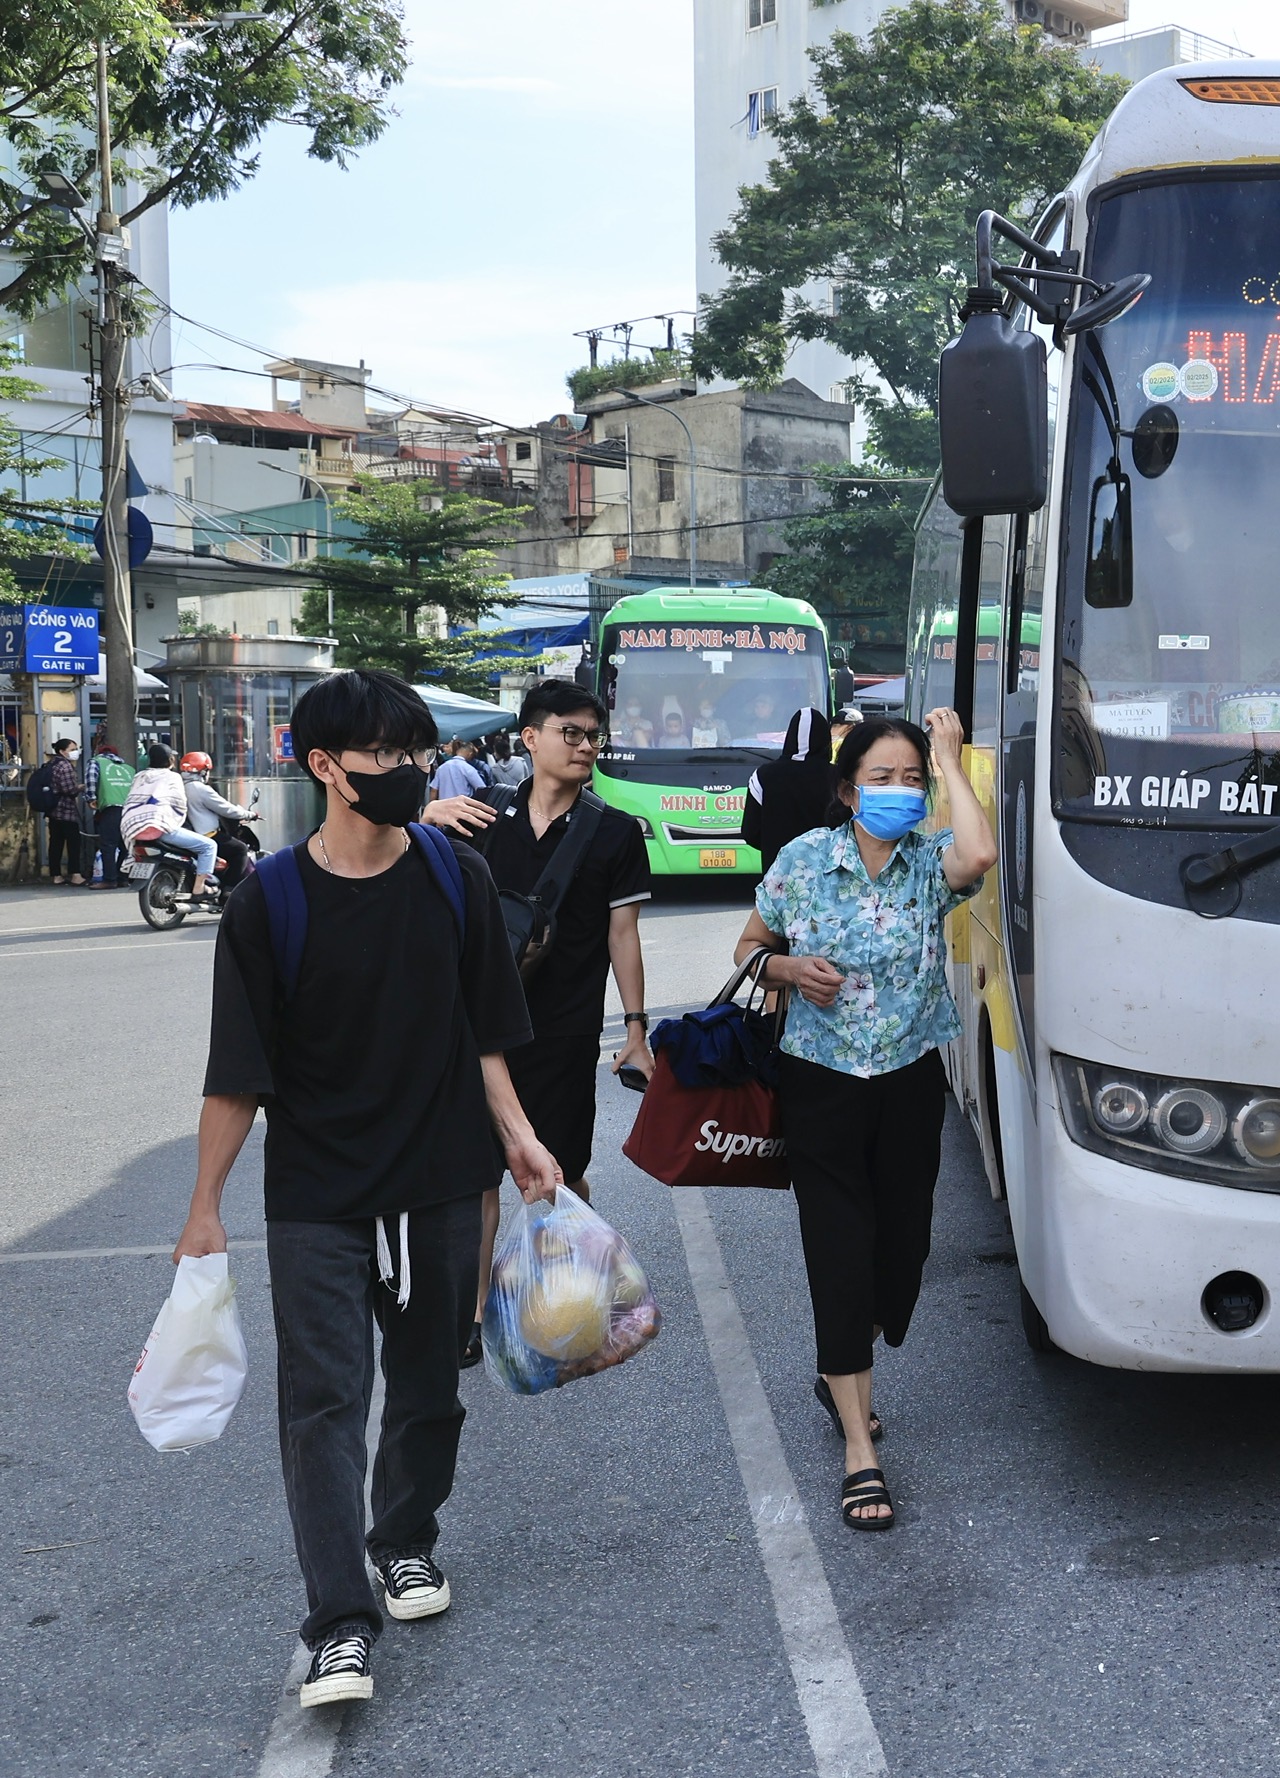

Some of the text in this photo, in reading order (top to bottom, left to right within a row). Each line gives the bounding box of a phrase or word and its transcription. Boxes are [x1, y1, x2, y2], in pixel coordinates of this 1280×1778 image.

[1149, 376, 1175, 384] 02/2025
[1187, 373, 1209, 381] 02/2025
[557, 583, 589, 596] YOGA
[0, 610, 11, 627] ỔNG
[29, 609, 96, 628] CỔNG VÀO
[5, 630, 14, 653] 2
[54, 631, 72, 653] 2
[619, 625, 806, 654] NAM ĐỊNH HÀ NỘI
[42, 660, 85, 670] GATE IN
[1094, 770, 1278, 815] BX GIÁP BÁT
[660, 795, 708, 811] MINH
[698, 816, 741, 824] ISUZU
[694, 1120, 788, 1164] Suprem
